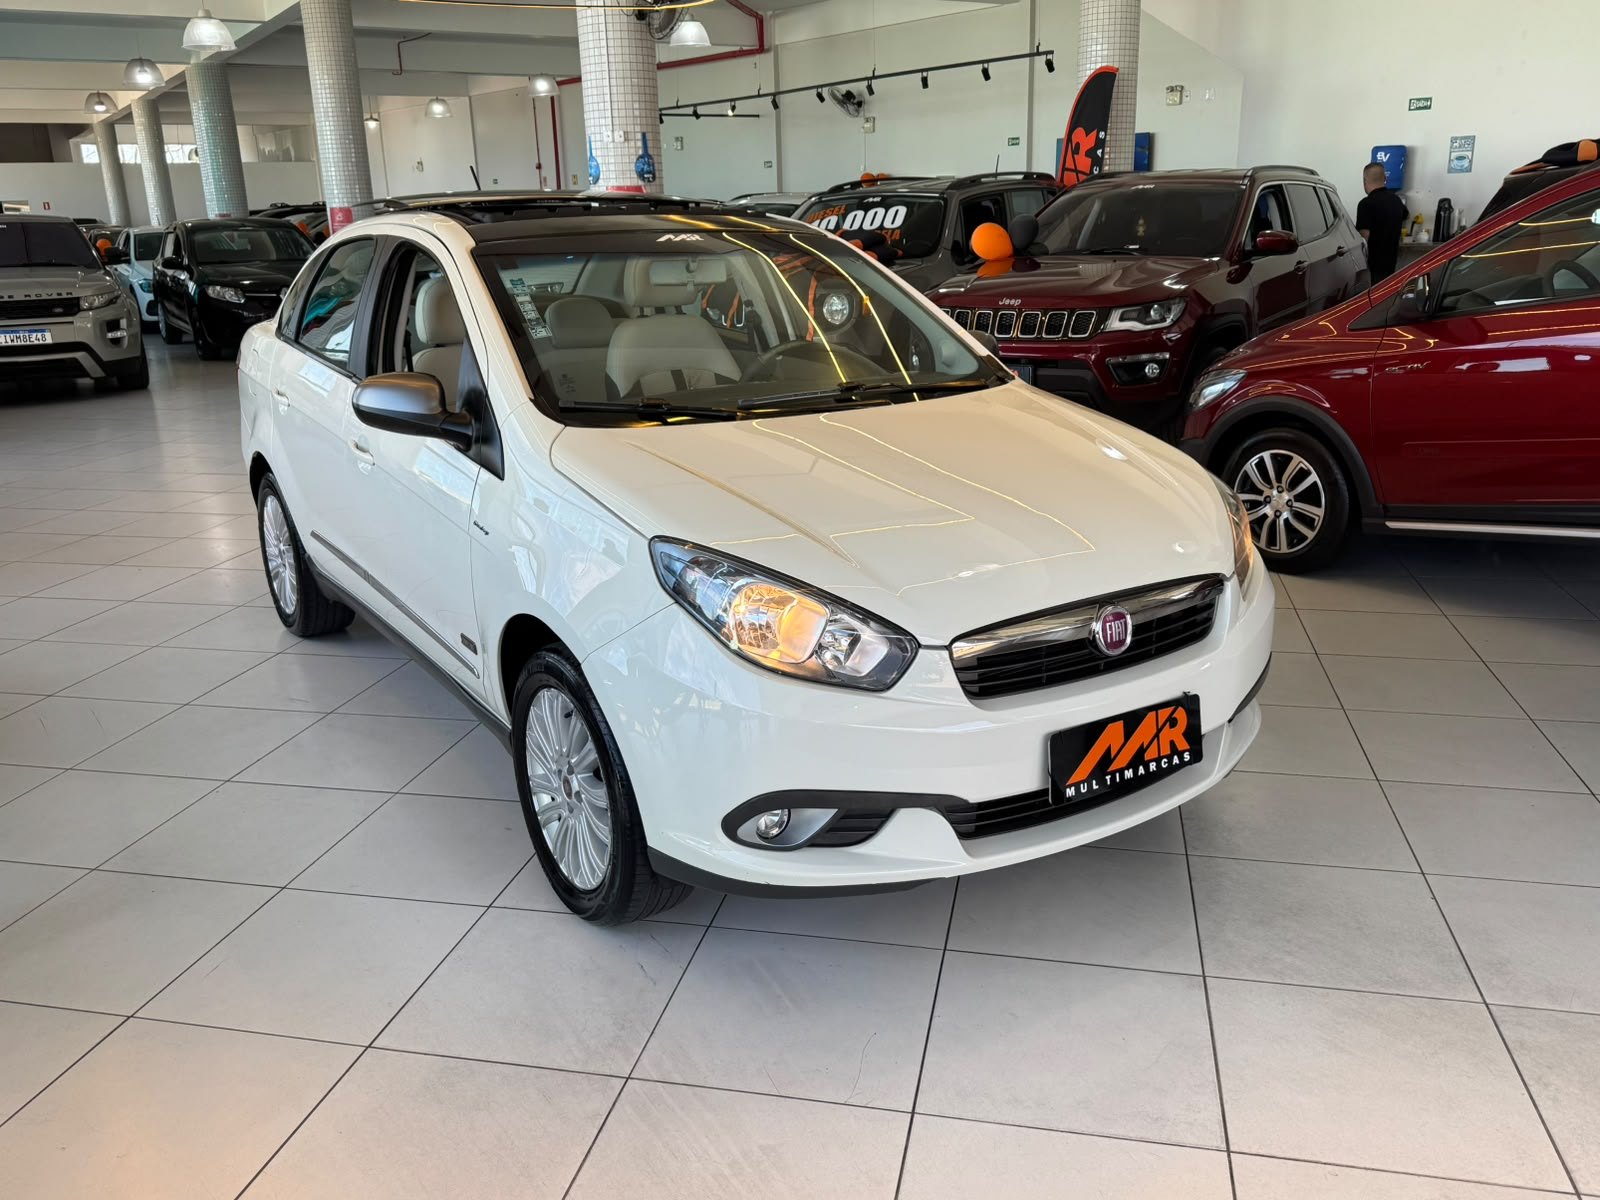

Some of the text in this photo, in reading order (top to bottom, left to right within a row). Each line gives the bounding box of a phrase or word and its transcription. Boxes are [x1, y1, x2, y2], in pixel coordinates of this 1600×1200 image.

[999, 297, 1021, 306] Jeep
[1106, 618, 1126, 643] FIAT
[1066, 751, 1191, 798] MULTIMARCAS
